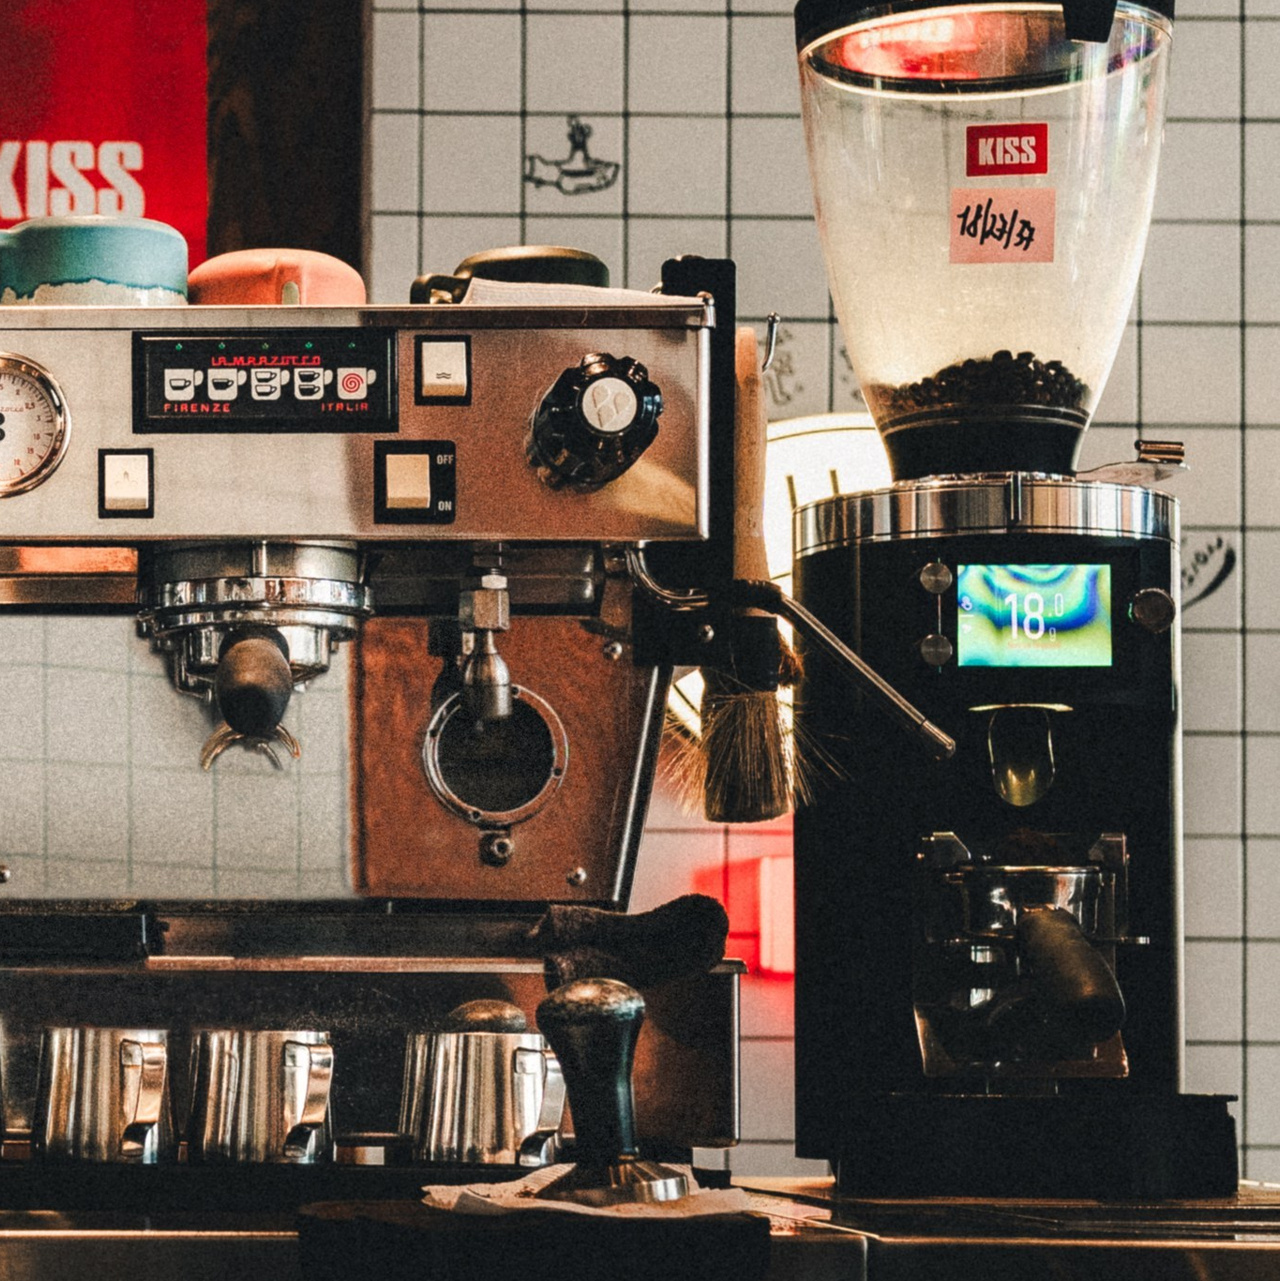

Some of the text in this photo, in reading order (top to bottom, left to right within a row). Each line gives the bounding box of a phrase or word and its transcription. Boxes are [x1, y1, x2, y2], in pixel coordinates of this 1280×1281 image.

[978, 136, 1036, 166] KISS
[164, 402, 369, 413] FIRENZE ITALIA
[436, 454, 454, 465] OFF
[438, 500, 452, 511] ON
